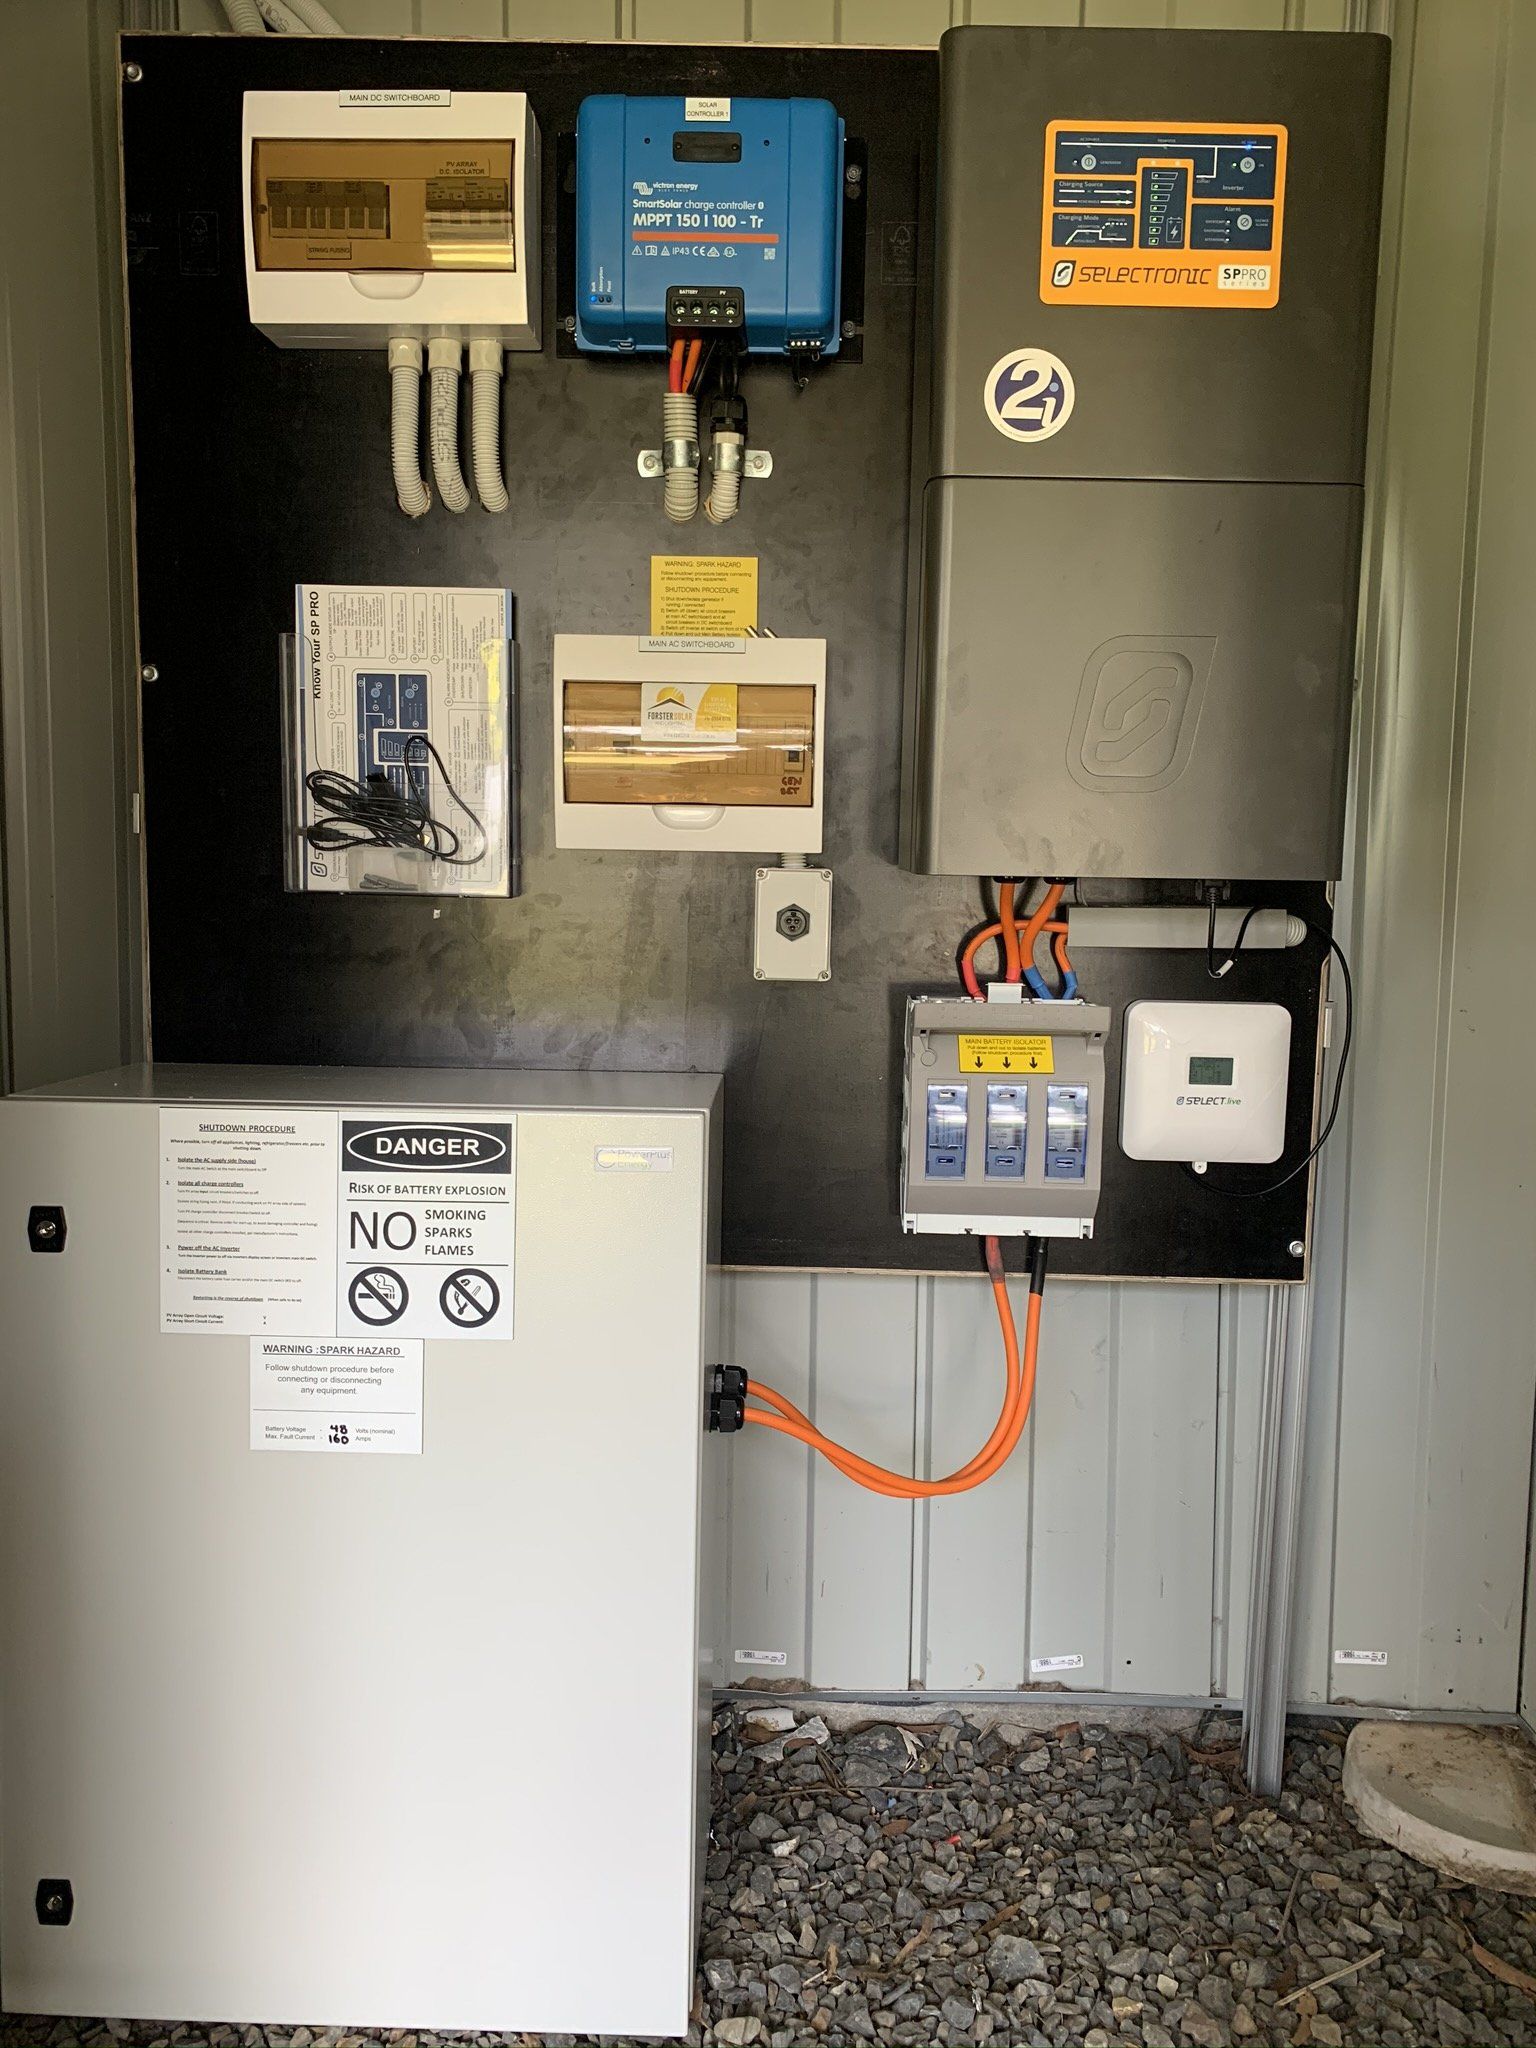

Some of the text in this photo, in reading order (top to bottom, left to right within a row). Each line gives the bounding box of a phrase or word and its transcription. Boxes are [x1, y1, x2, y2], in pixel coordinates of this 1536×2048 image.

[633, 199, 756, 211] SmartSolar charge controller
[633, 213, 672, 226] MPPT
[676, 214, 700, 227] 150
[712, 215, 737, 228] 100
[750, 216, 764, 228] Tr
[672, 247, 690, 255] IP43
[310, 591, 321, 699] Know Your SP PRO
[199, 1124, 296, 1133] SHUTDOWN PROCEDURE
[376, 1138, 479, 1156] DANGER
[349, 1182, 506, 1196] RISK OF BATTERY EXPLOSION
[425, 1209, 486, 1220] SMOKING
[350, 1211, 417, 1250] NO
[425, 1227, 472, 1238] SPARKS
[425, 1245, 474, 1256] FLAMES
[263, 1344, 313, 1354] WARNING
[357, 1347, 401, 1355] HAZARD
[330, 1366, 368, 1374] procedure
[278, 1376, 318, 1384] connecting
[330, 1377, 382, 1386] disconnecting
[330, 1425, 348, 1434] 48
[328, 1434, 349, 1444] 160
